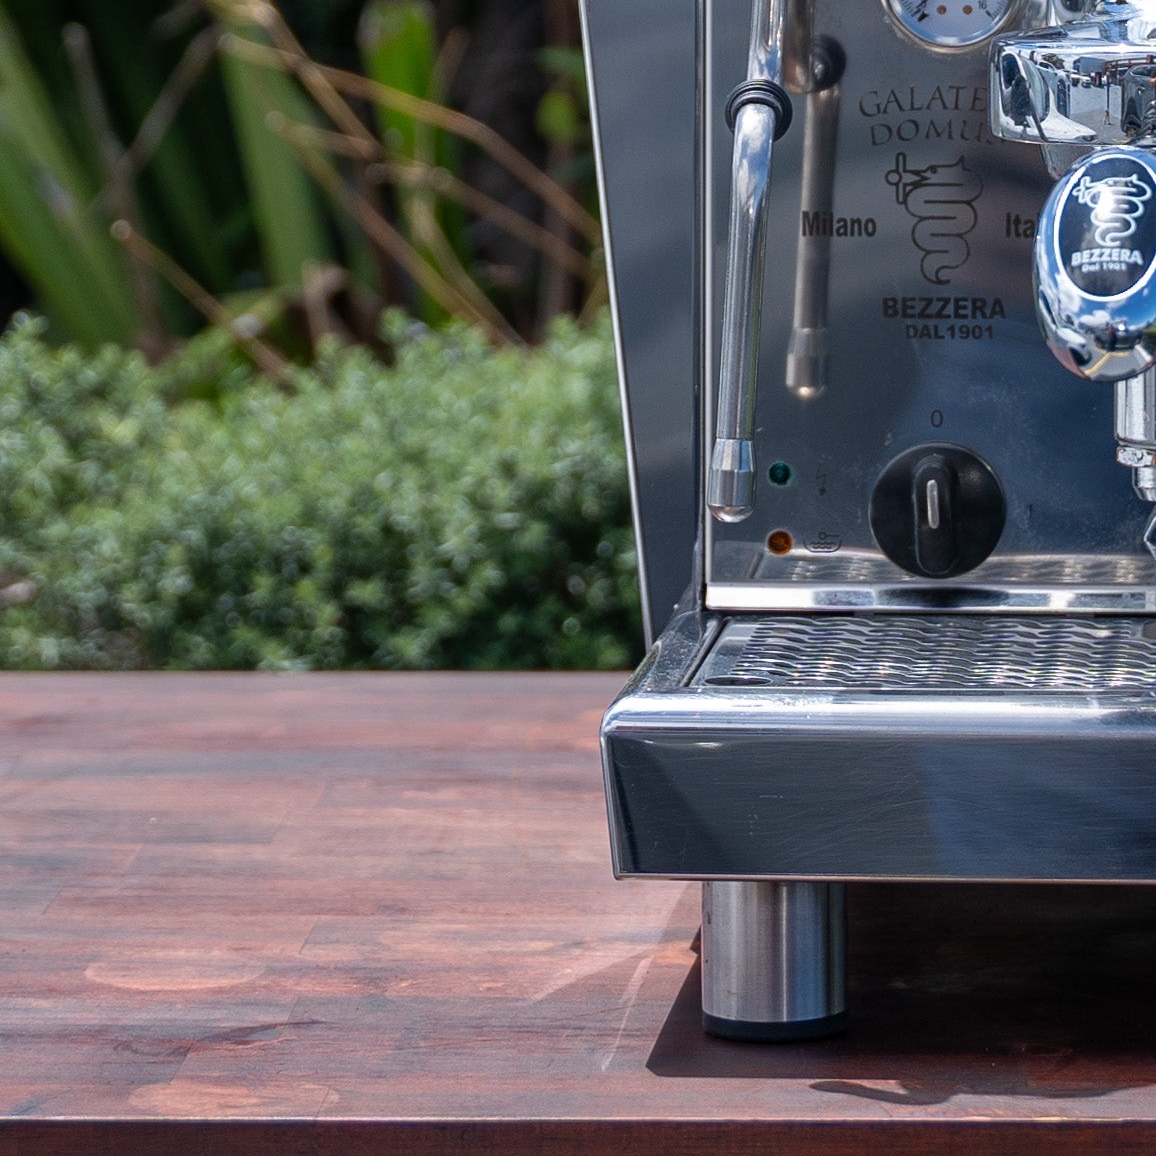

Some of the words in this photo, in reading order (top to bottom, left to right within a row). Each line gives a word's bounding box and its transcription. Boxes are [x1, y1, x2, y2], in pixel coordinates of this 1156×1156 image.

[978, 0, 987, 9] 16
[859, 85, 988, 117] GALATE
[870, 117, 992, 147] DOMU
[802, 210, 877, 238] Milano
[1005, 211, 1038, 238] Ita
[1071, 247, 1144, 266] BEZZERA
[882, 297, 1007, 320] BEZZERA
